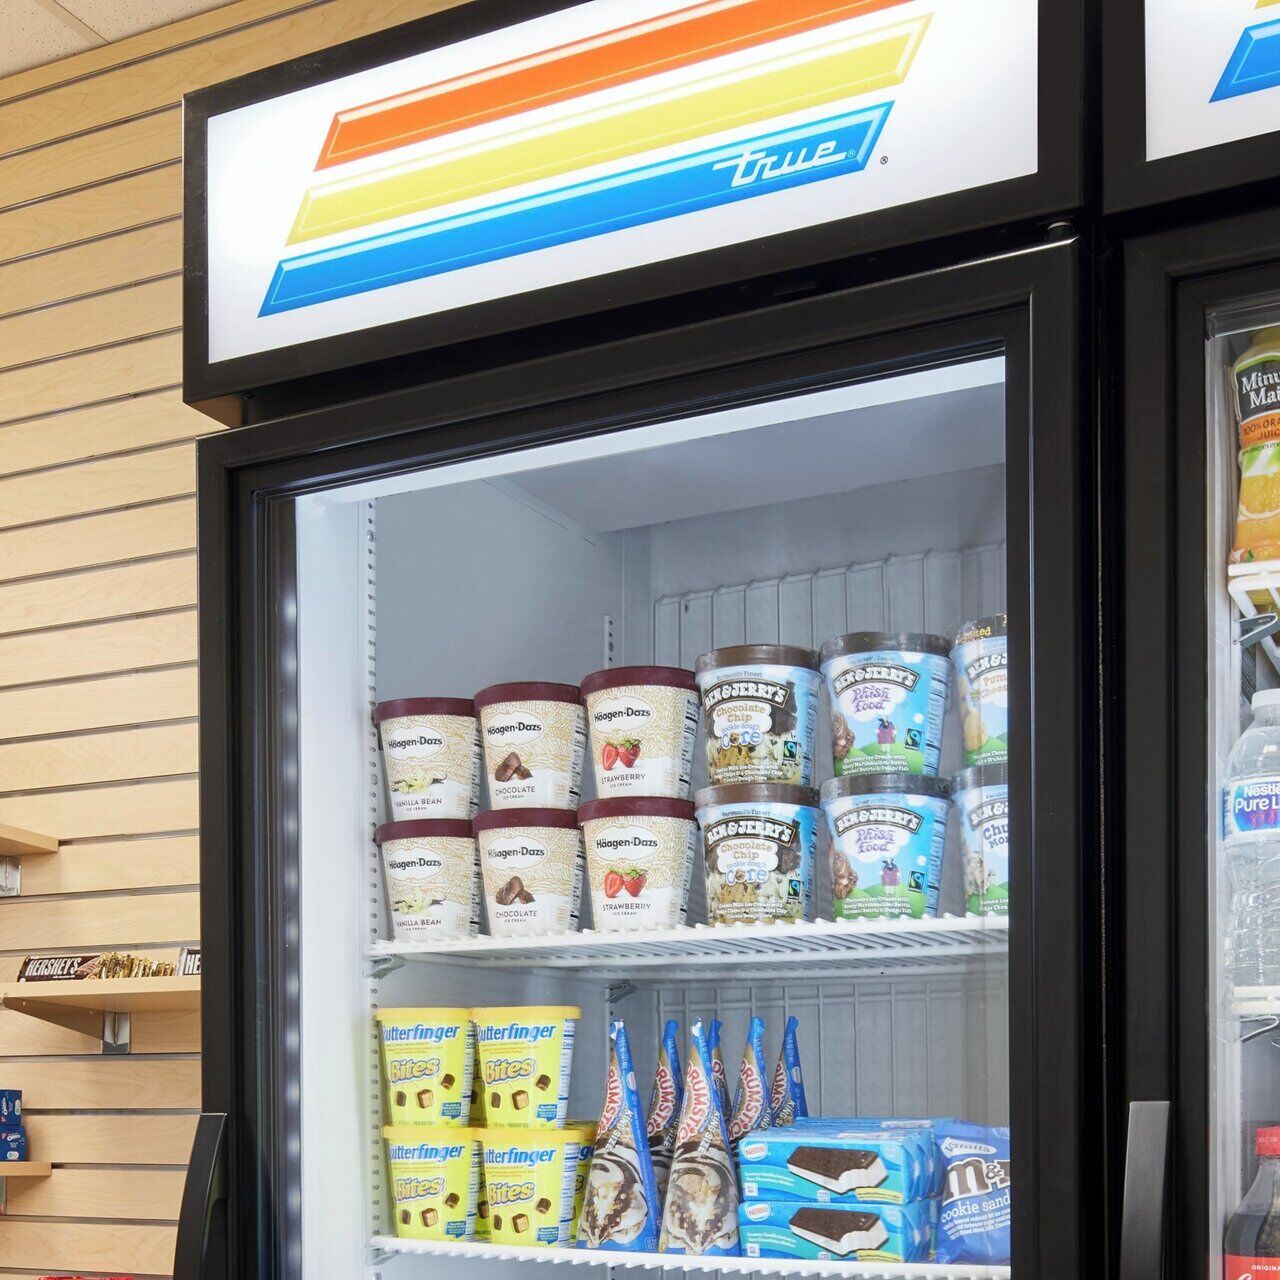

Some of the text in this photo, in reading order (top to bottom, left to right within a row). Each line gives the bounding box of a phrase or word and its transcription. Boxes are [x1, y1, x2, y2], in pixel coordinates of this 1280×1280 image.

[865, 667, 916, 687] JERRY'S
[594, 707, 651, 722] Häagen-Dazs
[487, 722, 542, 735] Häagen-Dazs
[601, 773, 646, 784] STRAWBERRY
[495, 785, 535, 795] CHOCOLATE
[421, 797, 442, 805] BEAN
[596, 837, 658, 849] Häagen-Dazs
[488, 847, 545, 860] Häagen-Dazs
[602, 903, 651, 911] STRAWBERRY
[496, 910, 538, 918] CHOCOLATE
[25, 958, 82, 976] HERSHEY'S
[391, 1059, 440, 1083] Bites
[486, 1058, 536, 1083] Bites
[396, 1178, 444, 1201] Bites
